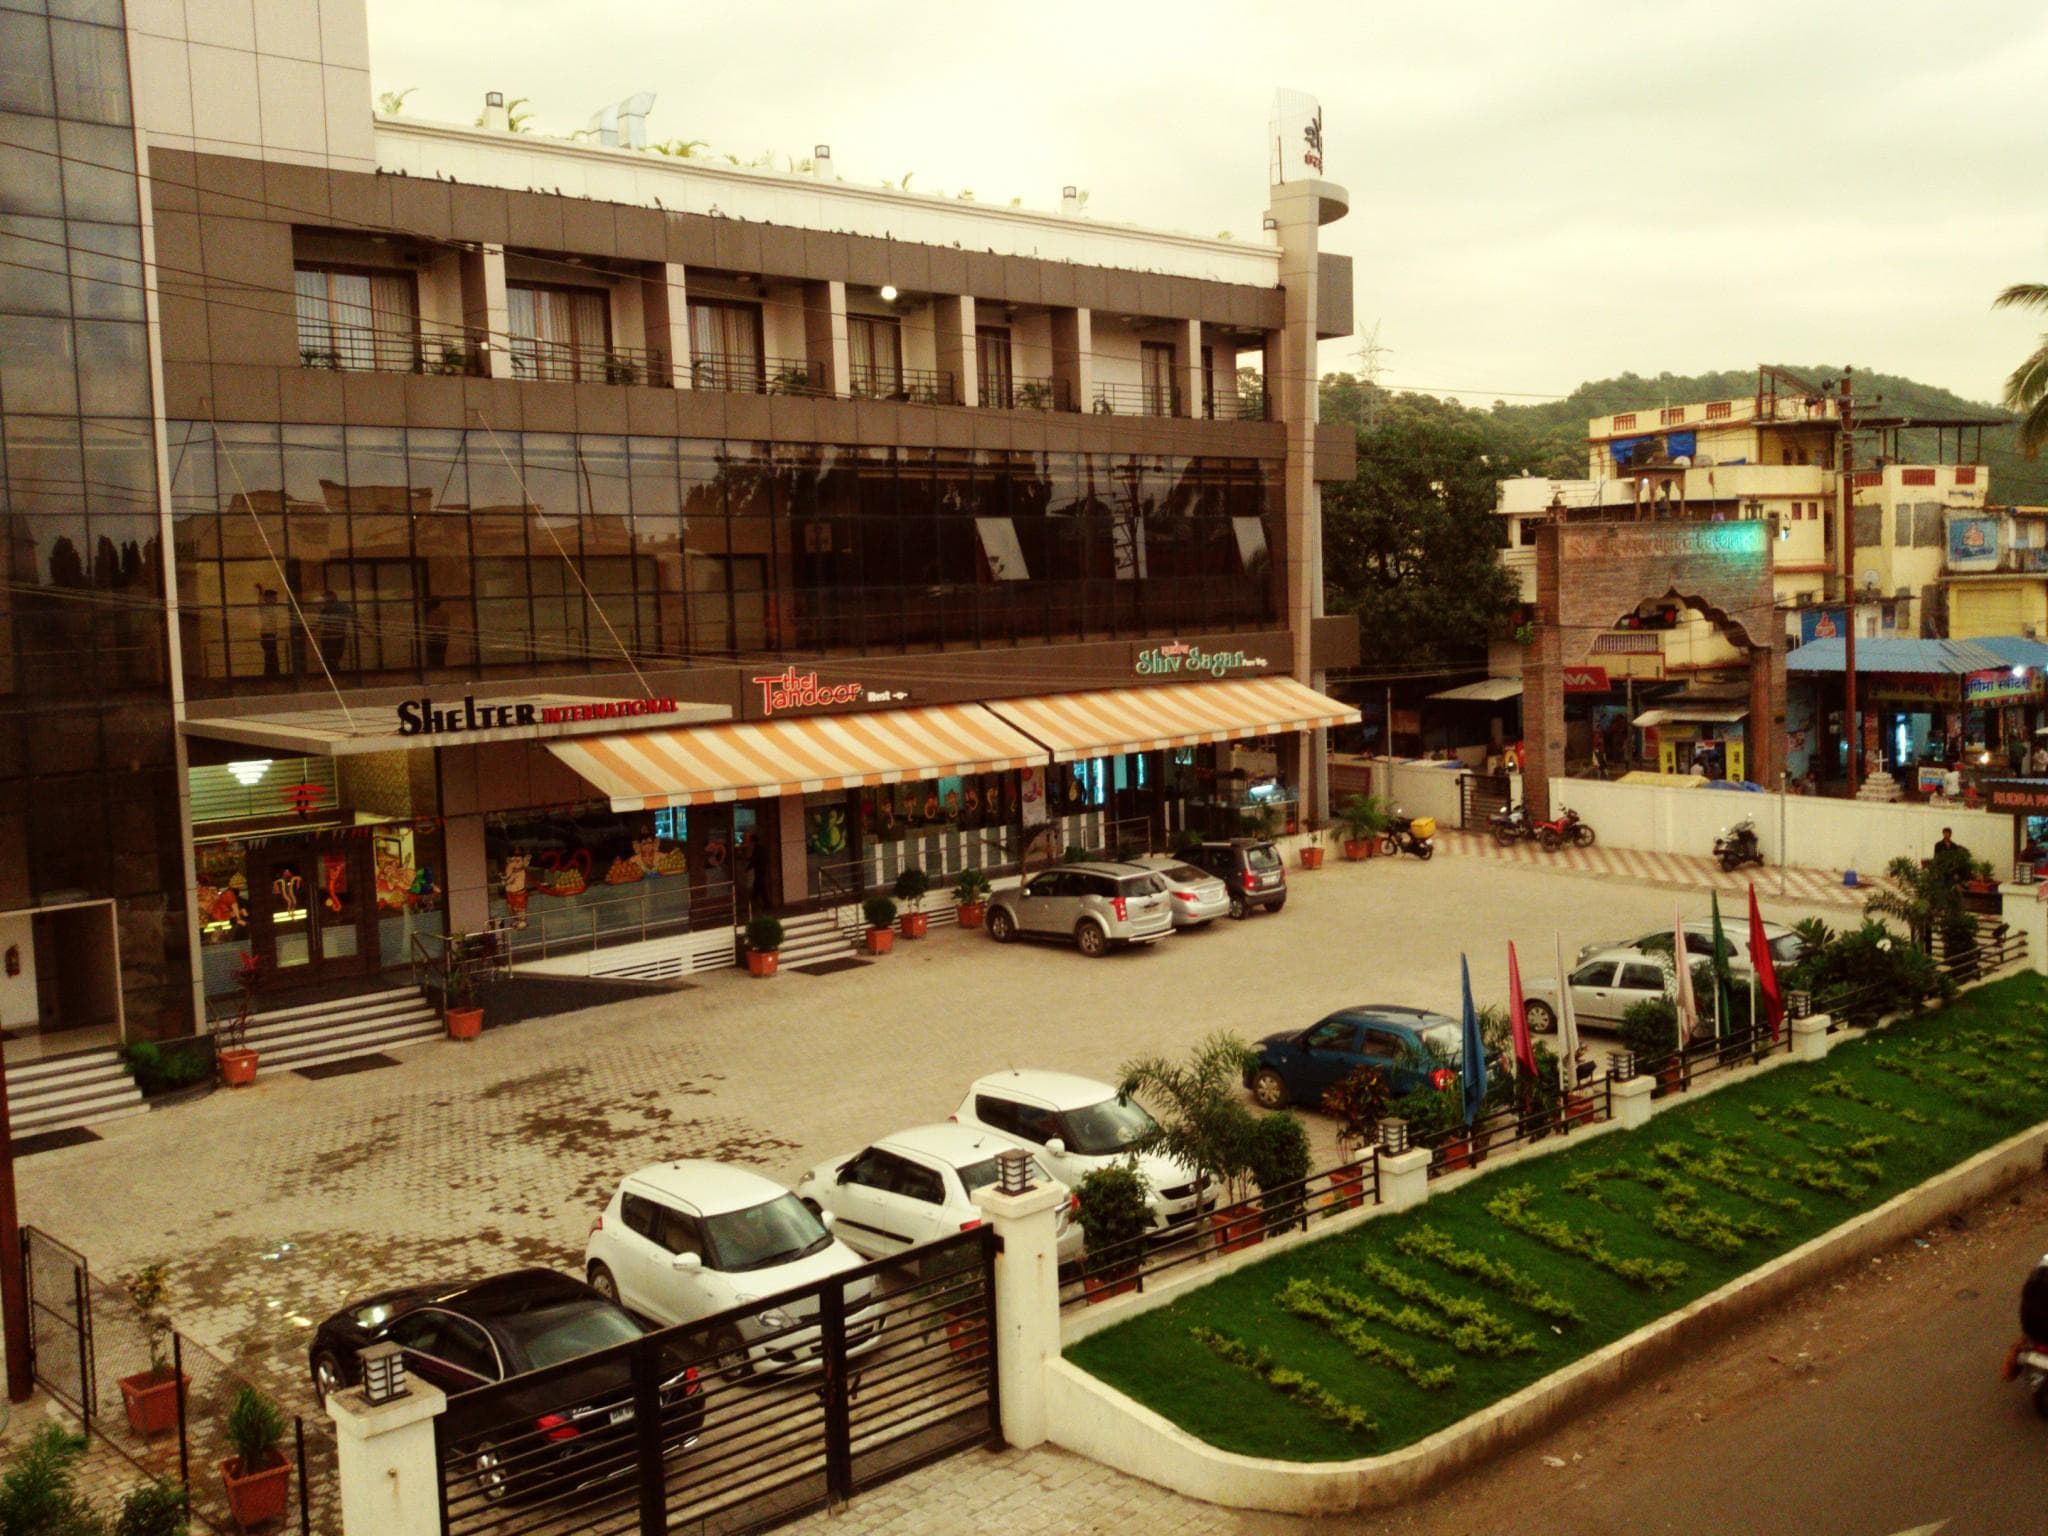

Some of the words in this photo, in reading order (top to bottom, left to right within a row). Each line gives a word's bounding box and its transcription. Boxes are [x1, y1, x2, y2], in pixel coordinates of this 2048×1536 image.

[1136, 649, 1182, 674] Shiv
[1186, 647, 1244, 677] Sagar
[782, 666, 810, 690] the
[752, 672, 862, 716] Tandoor
[541, 696, 678, 724] INTERNATIONAL
[1993, 791, 2034, 805] RUDRA
